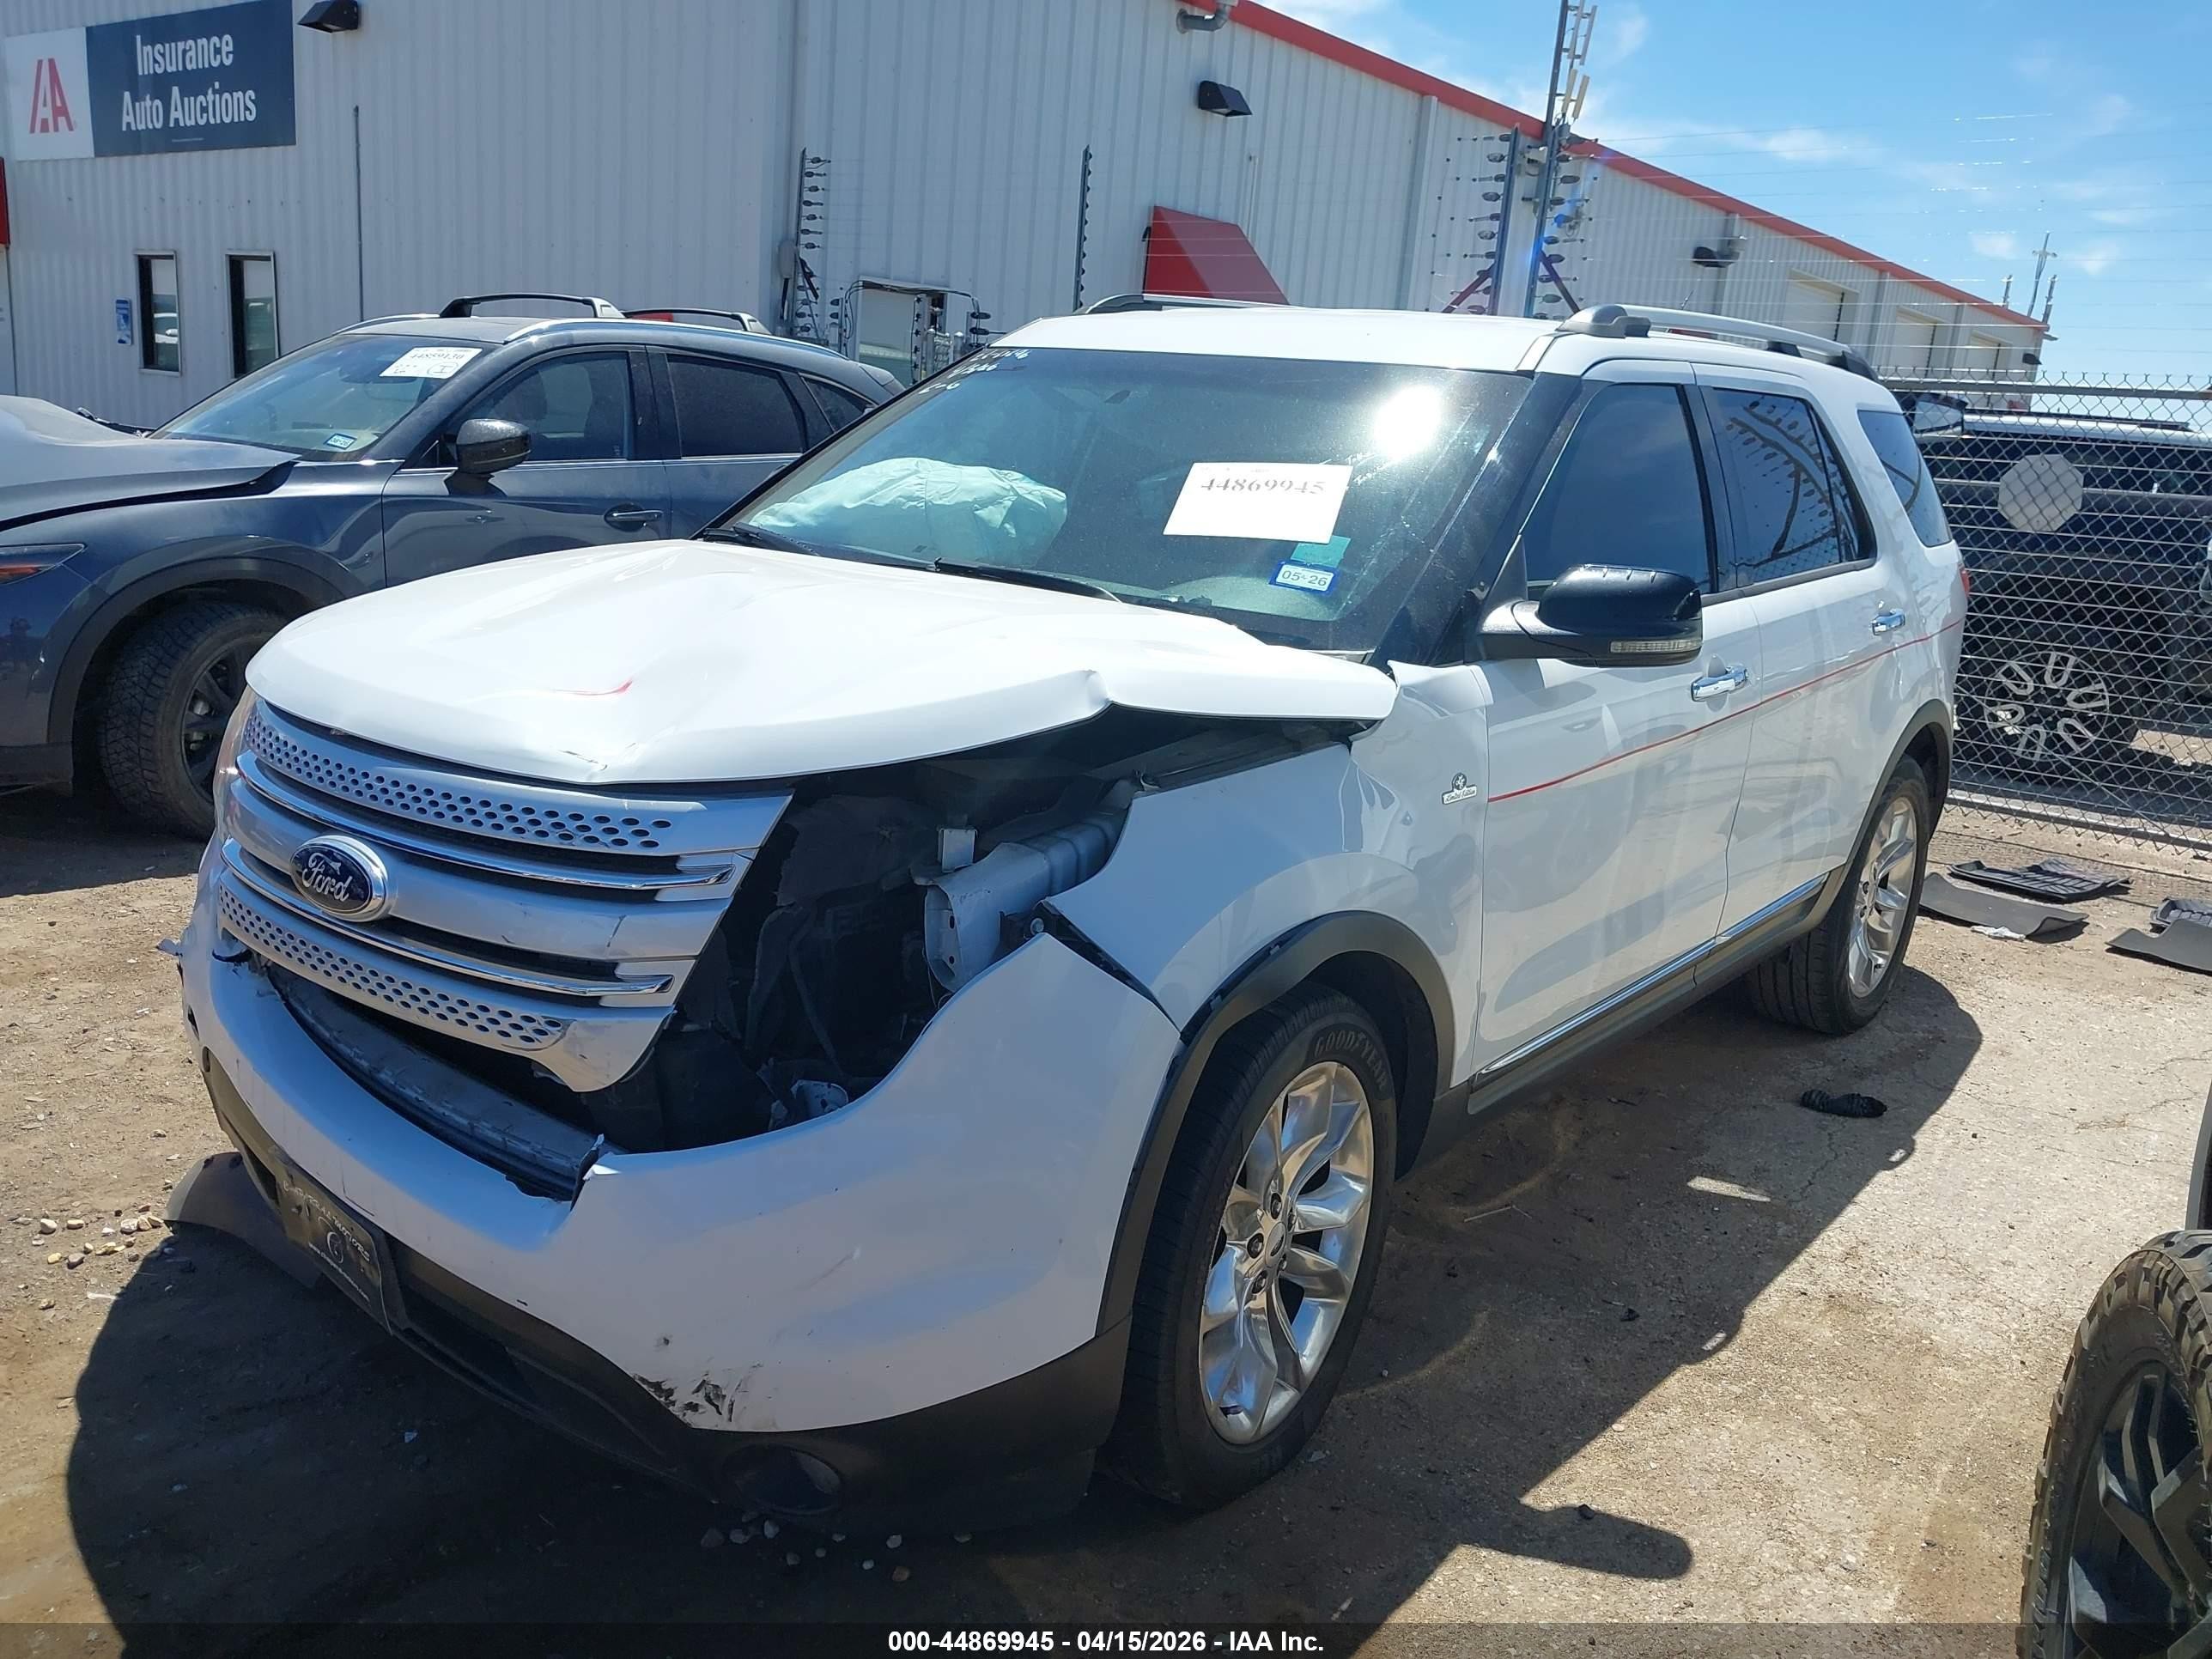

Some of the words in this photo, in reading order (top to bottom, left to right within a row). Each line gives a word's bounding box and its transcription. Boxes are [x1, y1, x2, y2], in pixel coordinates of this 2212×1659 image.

[136, 33, 234, 76] Insurance
[122, 90, 163, 131] Auto
[169, 82, 257, 127] Auctions
[1200, 477, 1327, 495] 44869945
[301, 852, 354, 902] Ford
[1315, 1030, 1388, 1091] GOODYEAR
